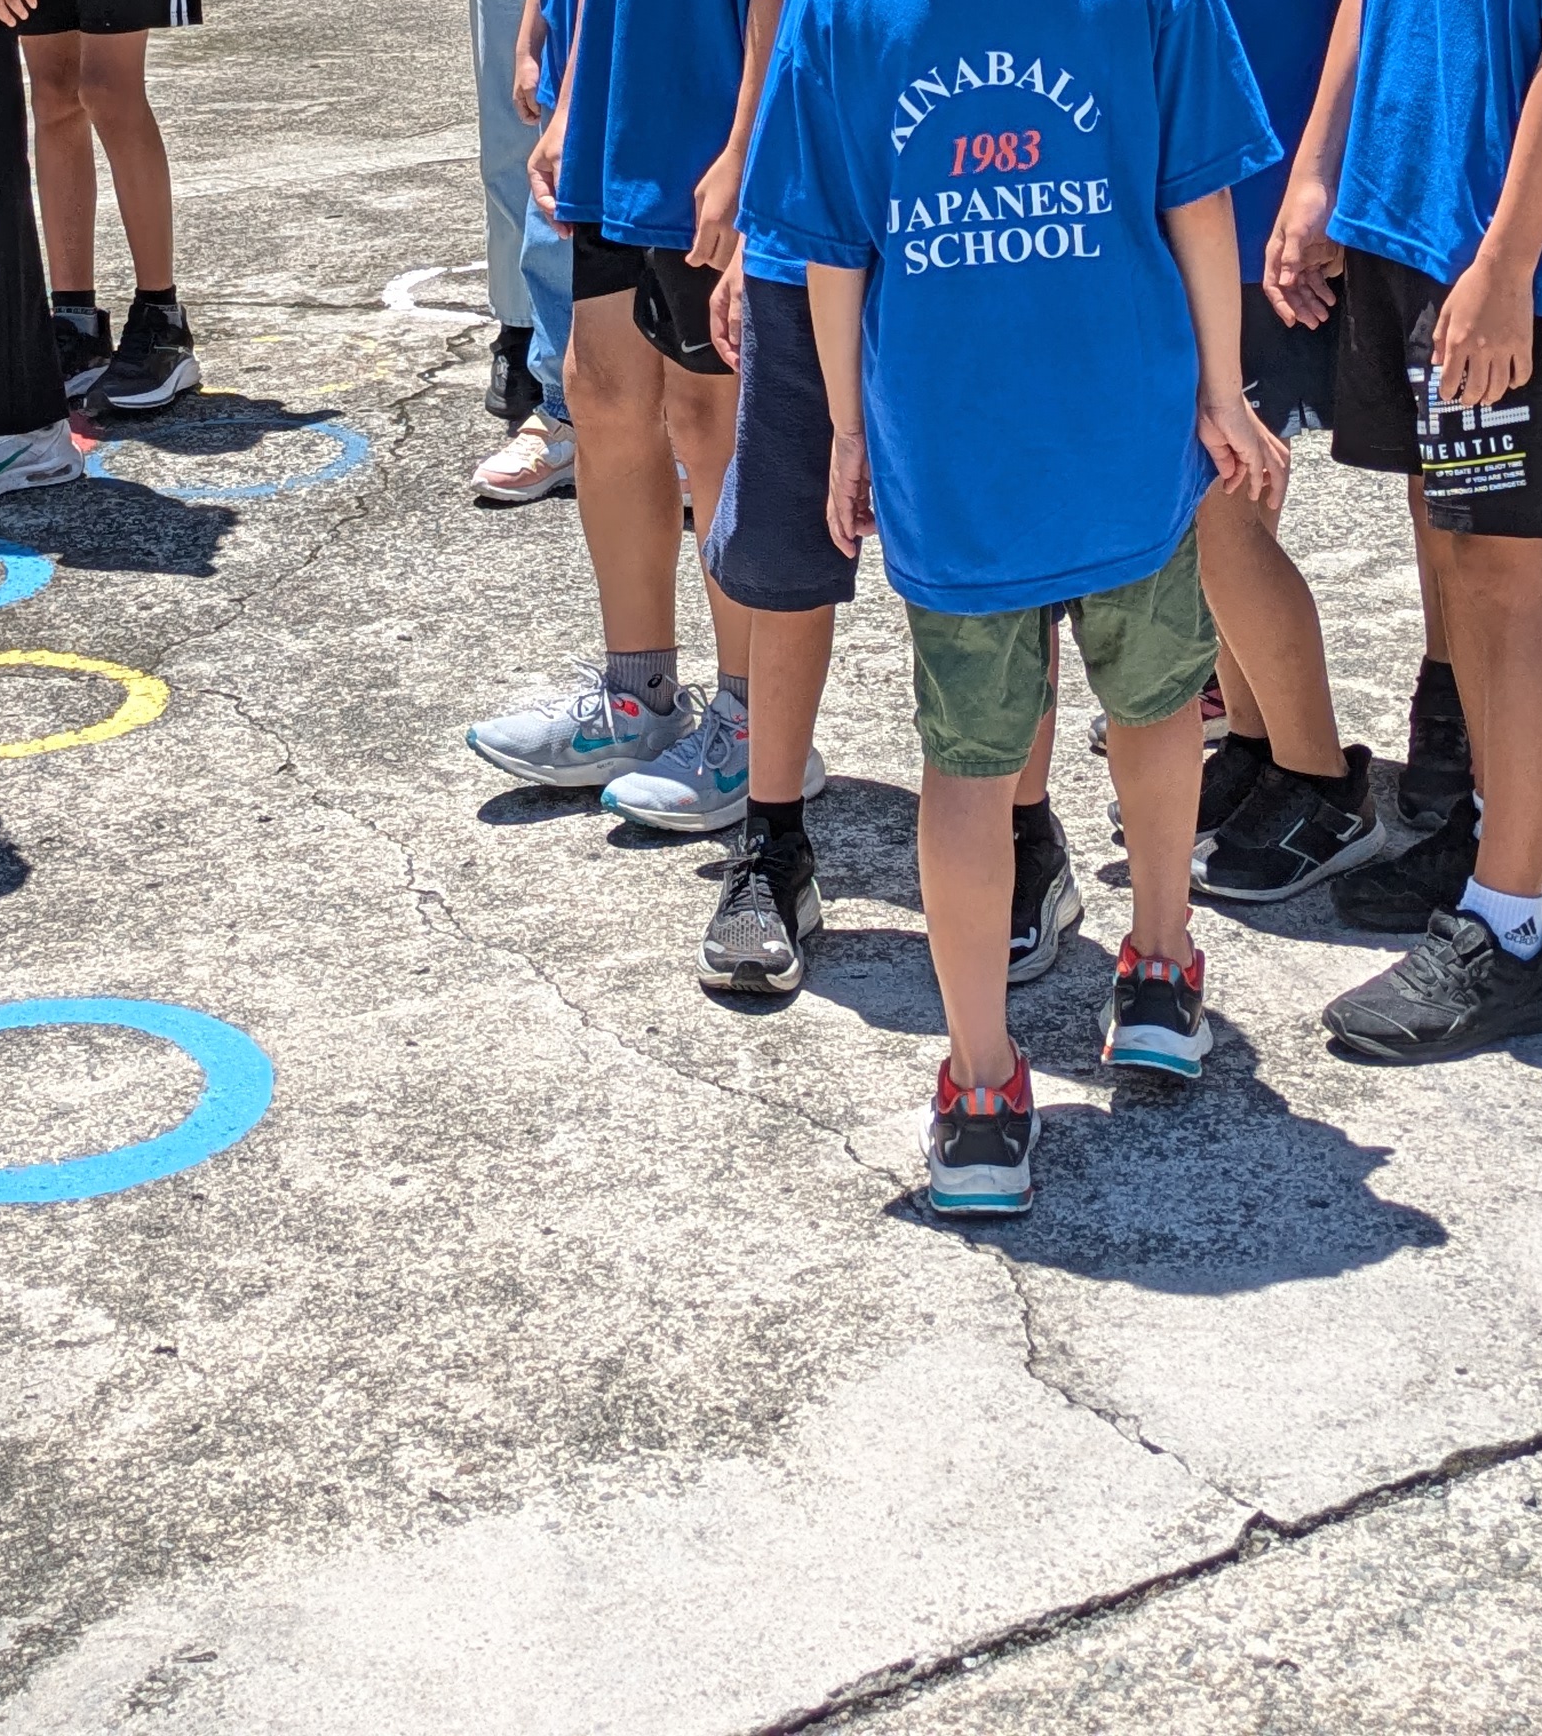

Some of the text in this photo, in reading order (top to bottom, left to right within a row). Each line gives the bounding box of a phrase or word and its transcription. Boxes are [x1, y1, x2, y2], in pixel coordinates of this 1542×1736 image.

[948, 130, 1042, 177] 1983
[886, 178, 1113, 234] JAPANESE
[904, 224, 1101, 275] SCHOOL
